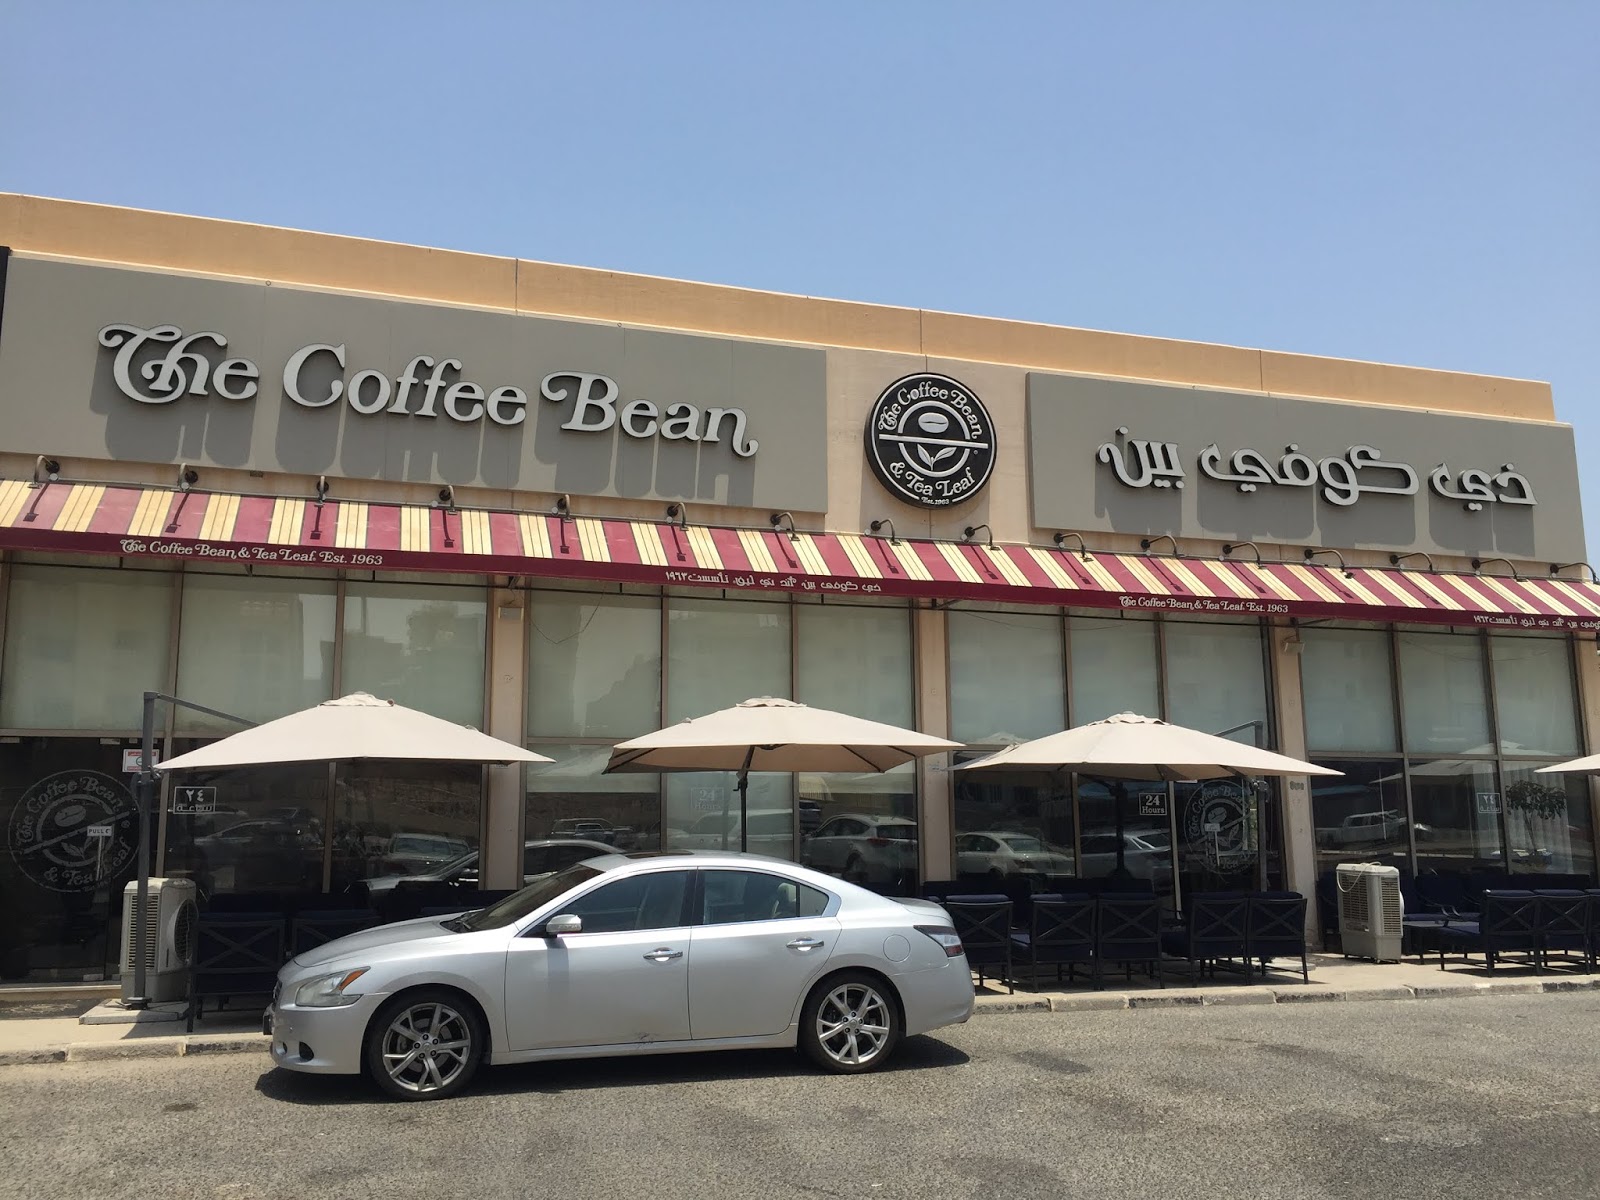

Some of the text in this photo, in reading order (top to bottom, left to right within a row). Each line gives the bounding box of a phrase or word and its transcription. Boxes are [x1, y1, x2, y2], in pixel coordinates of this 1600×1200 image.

[98, 323, 759, 458] The Coffee Bean
[878, 381, 983, 439] The Coffee Bean
[1096, 426, 1187, 490] بين
[890, 461, 975, 497] & Tea Leaf
[120, 539, 146, 553] The
[149, 541, 193, 554] Coffee
[195, 544, 237, 559] Bean
[238, 546, 251, 558] &
[251, 547, 277, 560] Tea
[319, 551, 347, 564] Est.
[350, 554, 383, 565] 1963
[1119, 595, 1137, 607] The
[1138, 597, 1166, 607] Coffee
[1166, 598, 1194, 610] Bean
[1203, 600, 1220, 610] Tea
[1267, 604, 1288, 613] 1963
[27, 780, 78, 813] Coffee
[80, 776, 124, 812] Bean
[1142, 806, 1165, 814] Hours
[1145, 795, 1160, 806] 24
[62, 869, 94, 886] Tea
